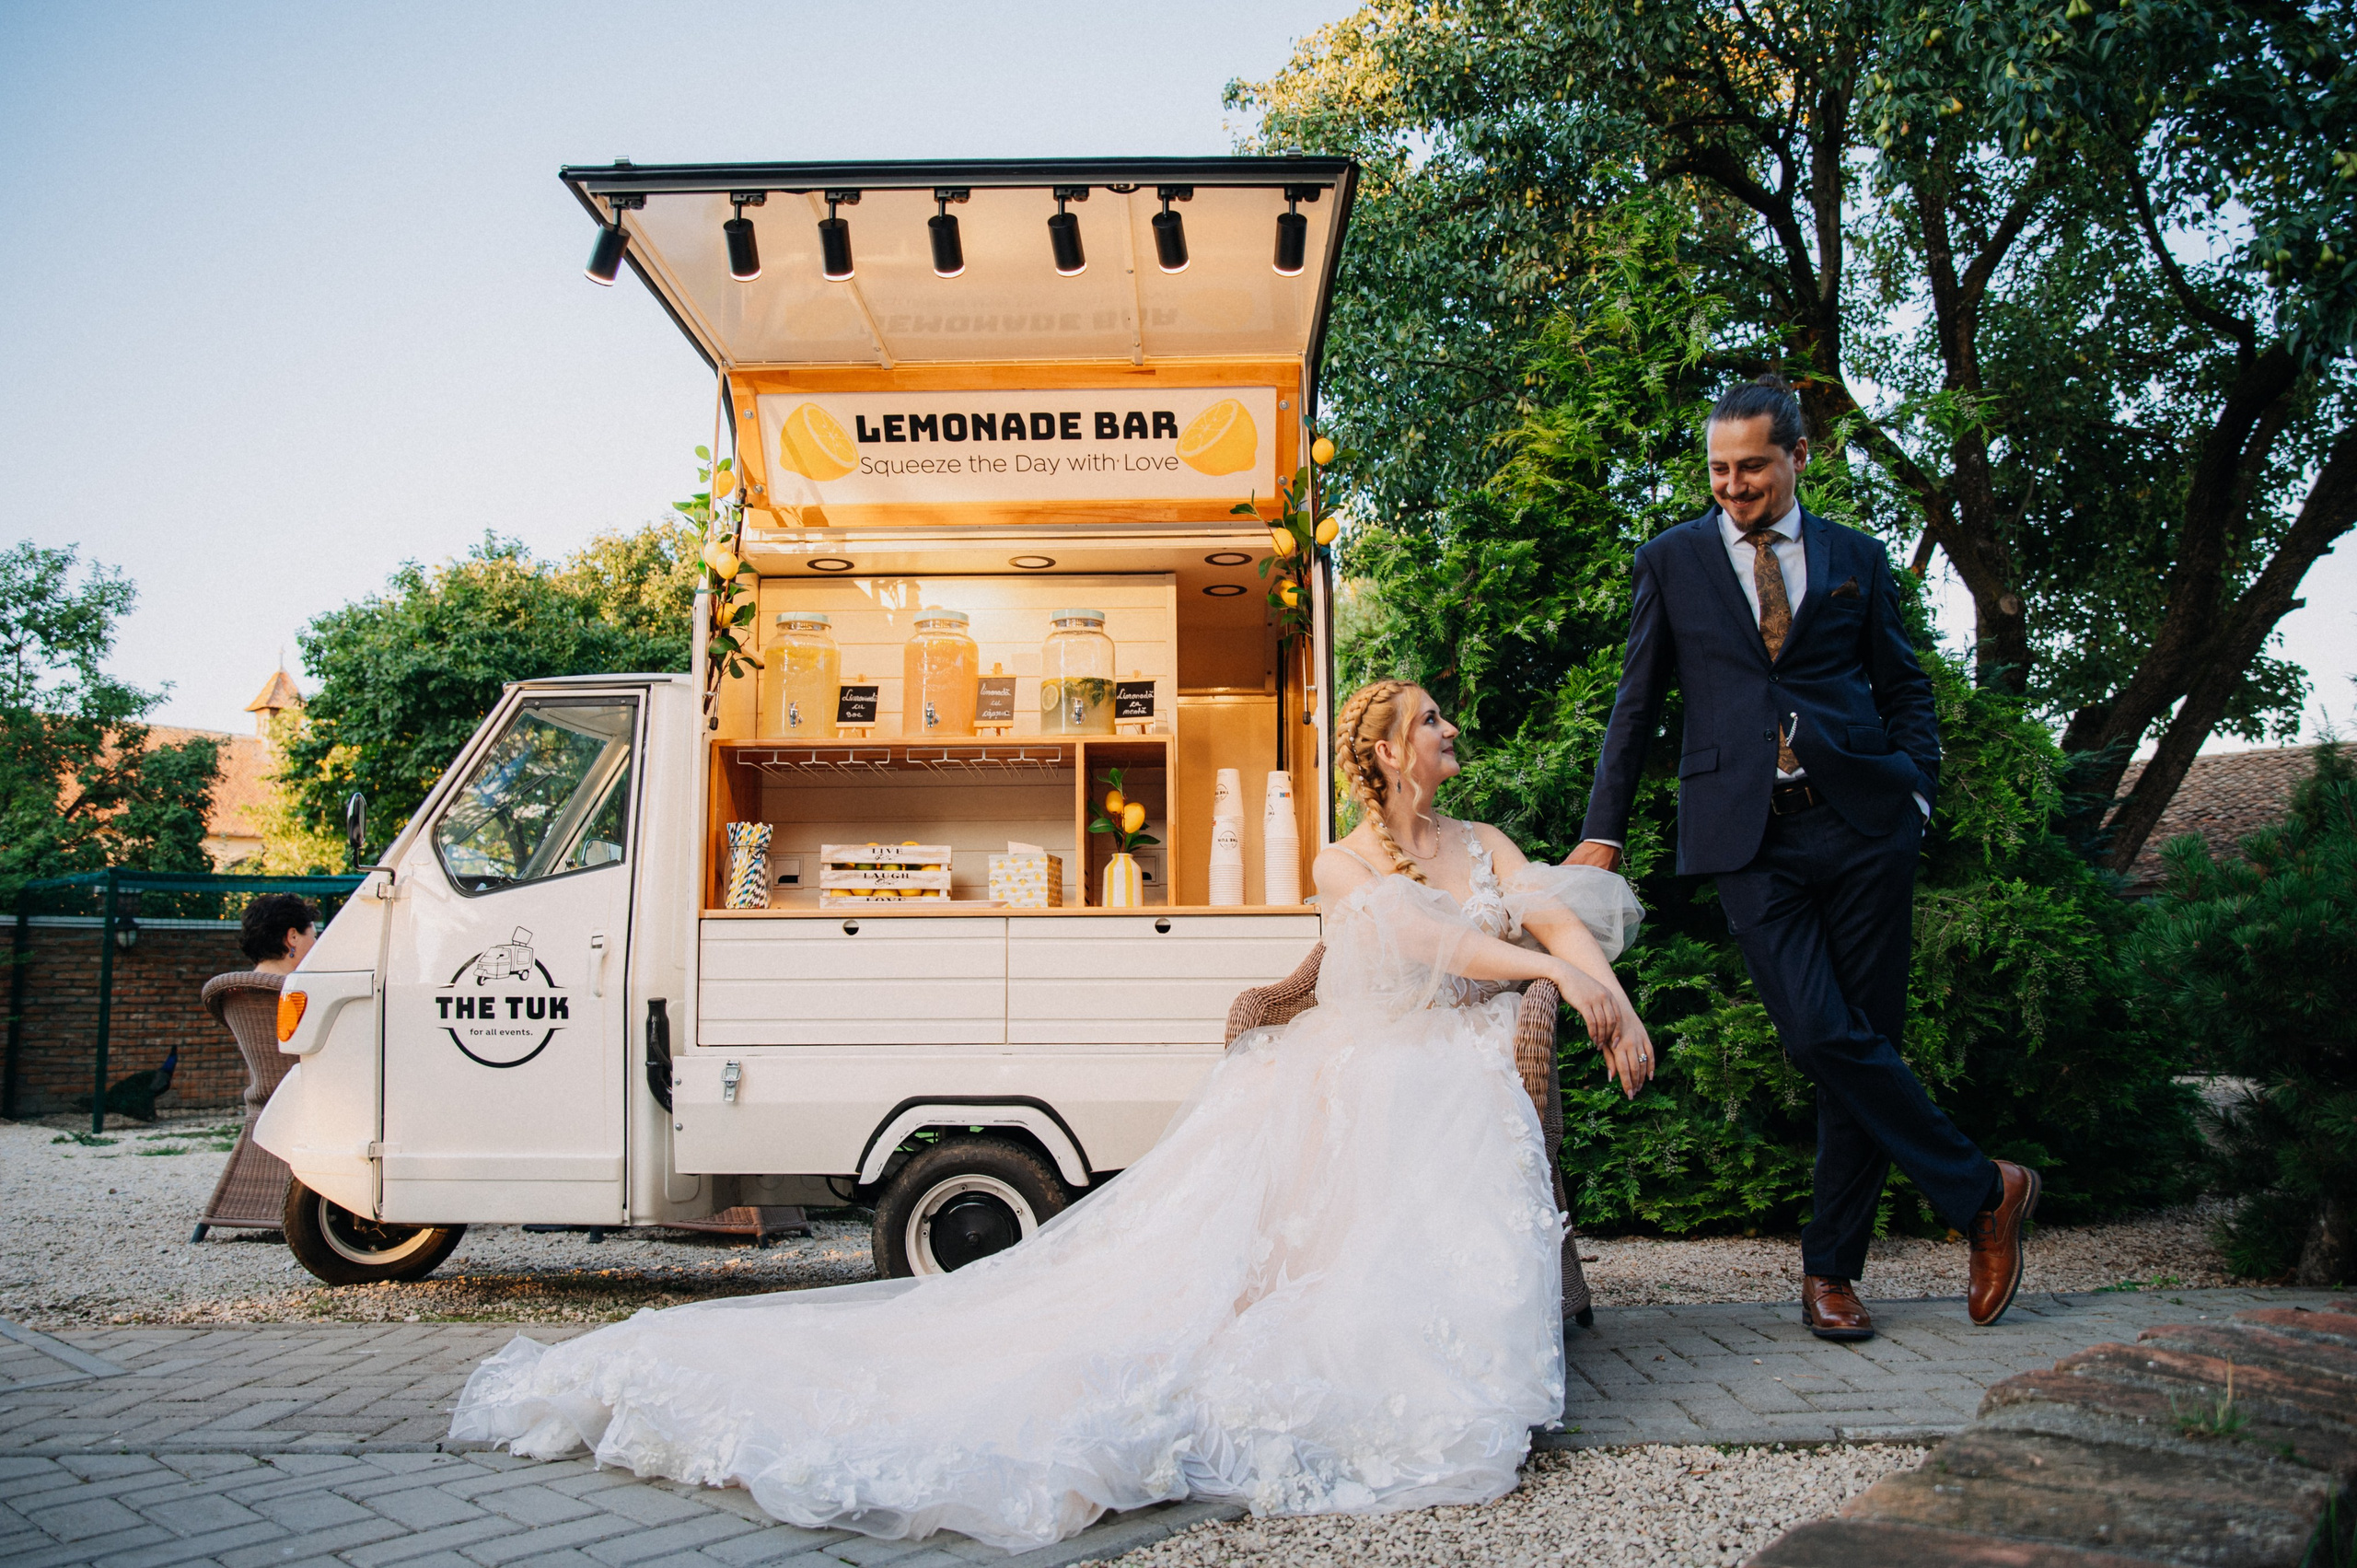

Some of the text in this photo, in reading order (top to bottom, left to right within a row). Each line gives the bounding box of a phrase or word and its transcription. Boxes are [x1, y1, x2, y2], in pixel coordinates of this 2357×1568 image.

[855, 412, 1178, 443] LEMONADE BAR
[861, 454, 1178, 477] Squeeze the Day with Love
[435, 997, 568, 1019] THE TUK
